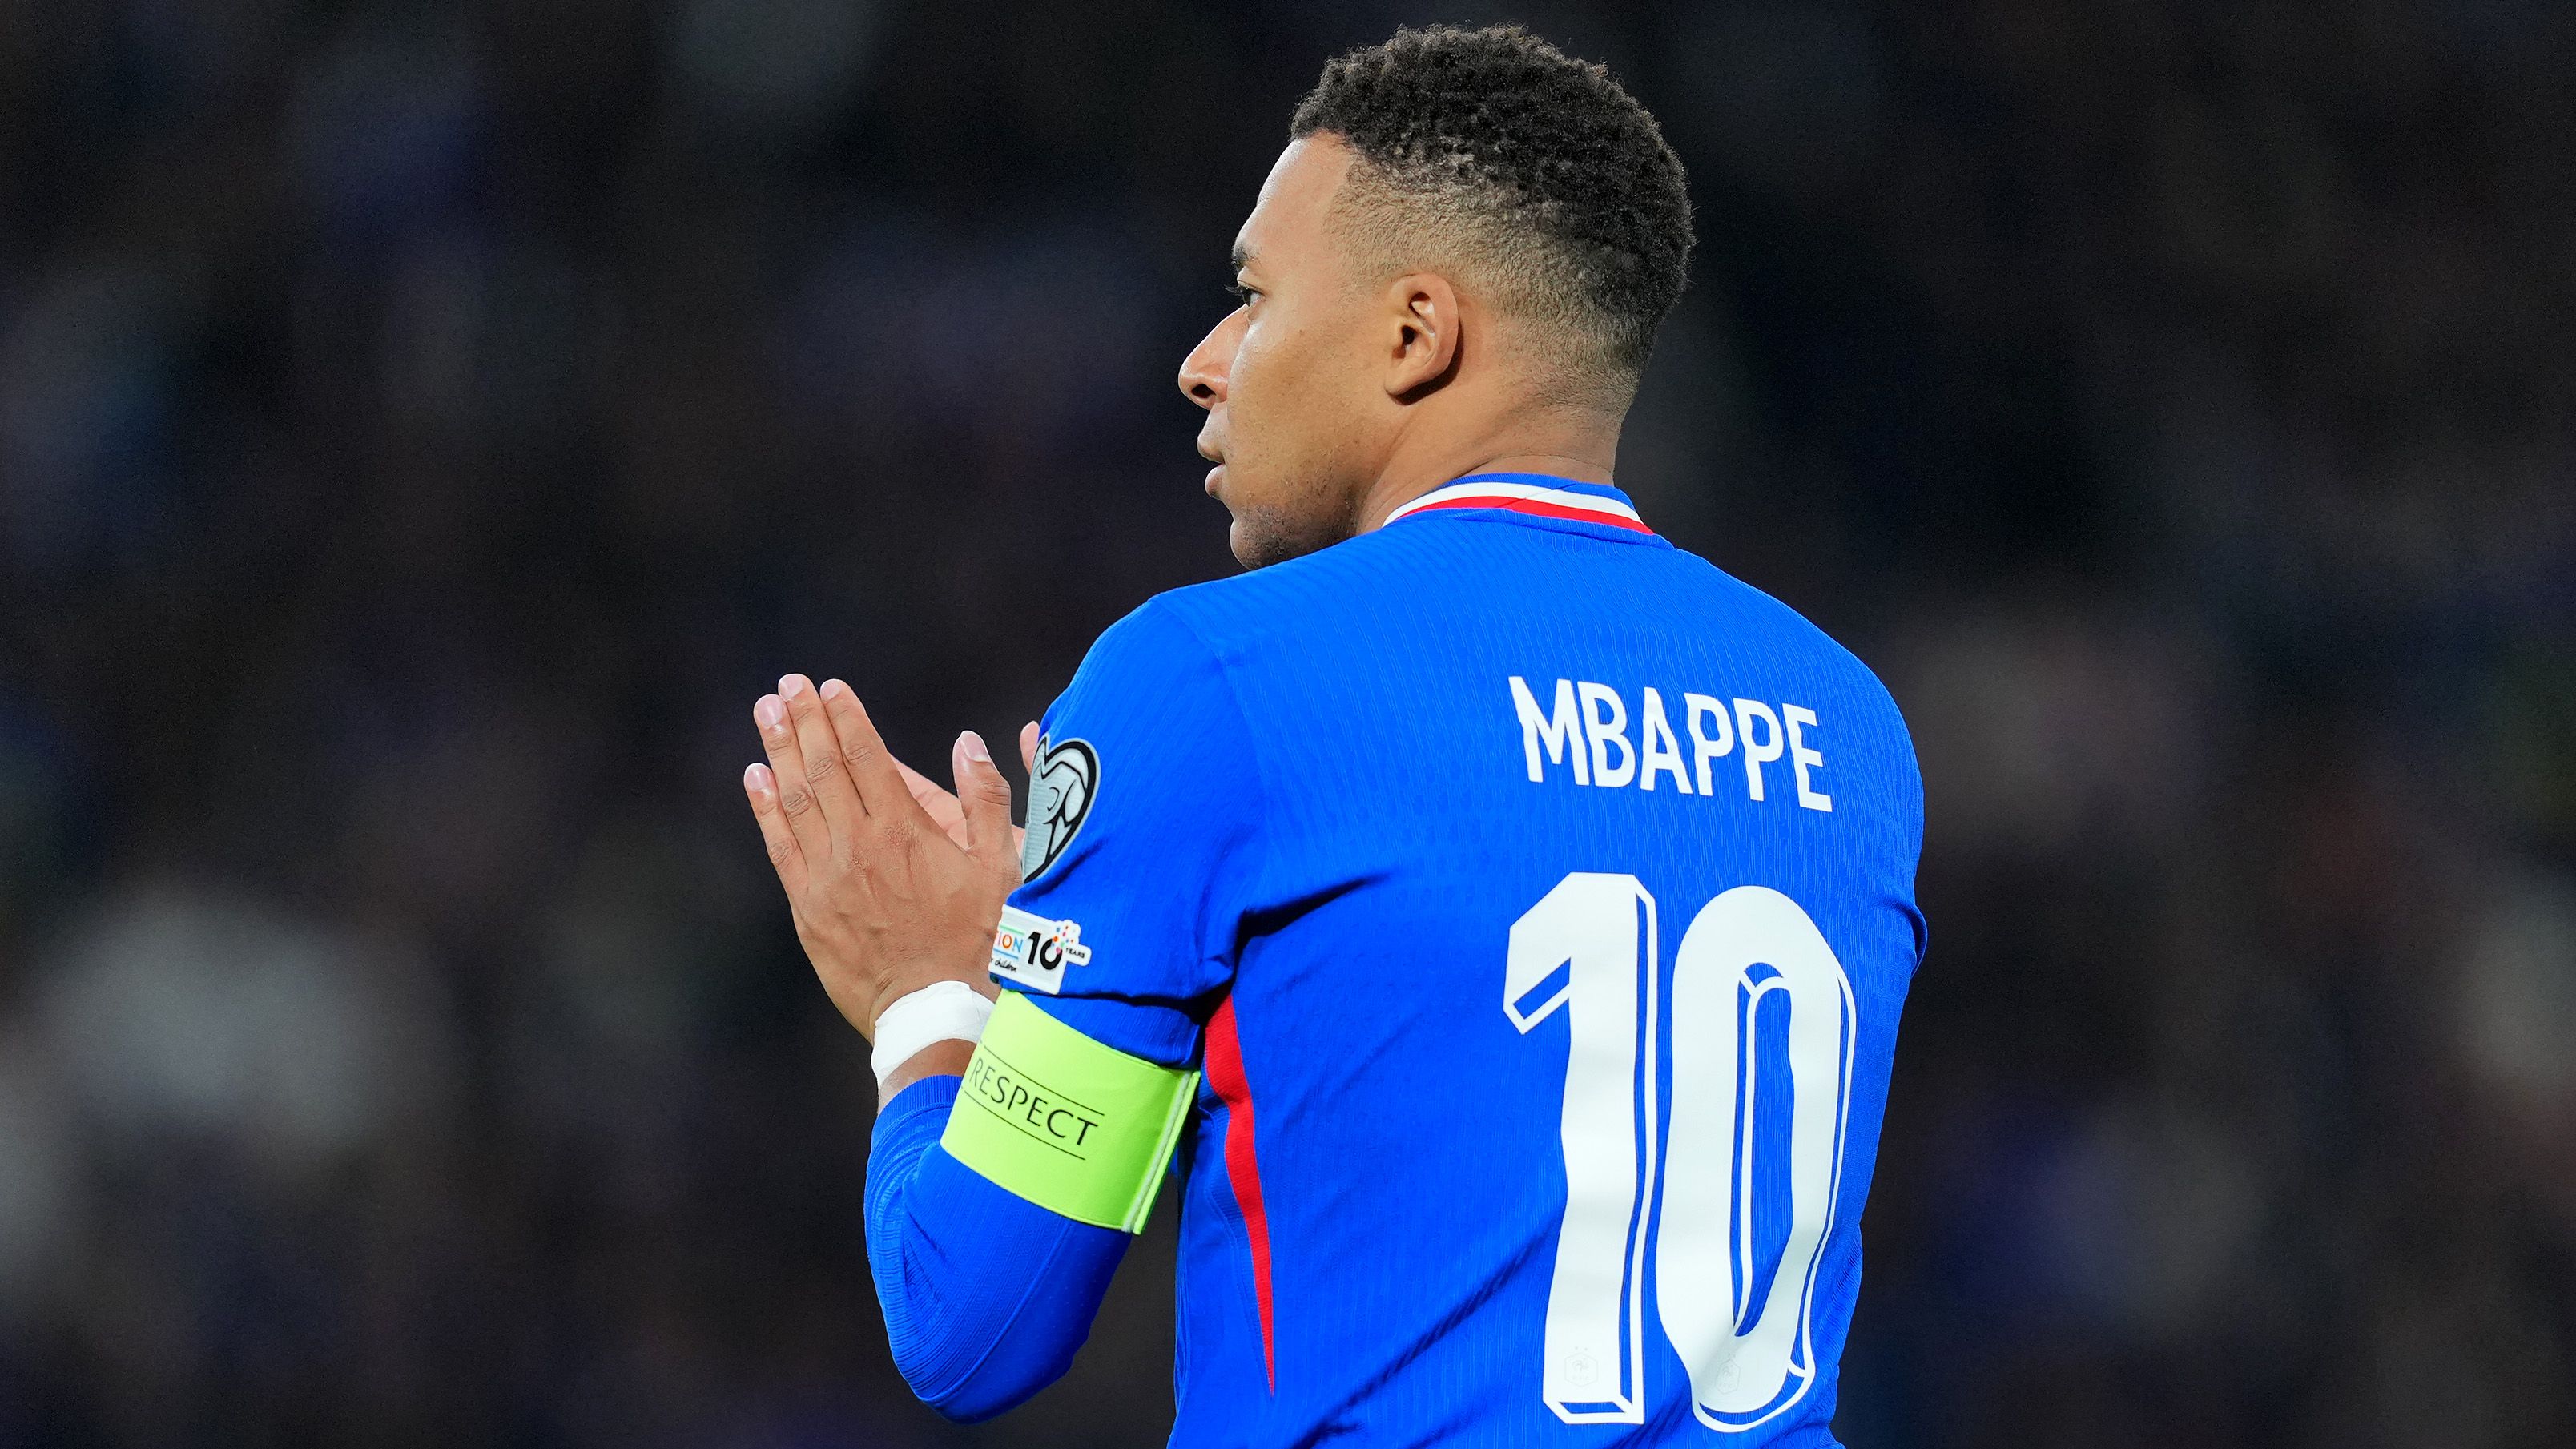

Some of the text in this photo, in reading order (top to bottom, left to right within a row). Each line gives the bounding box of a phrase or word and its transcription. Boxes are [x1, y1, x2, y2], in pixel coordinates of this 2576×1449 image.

[1508, 676, 1833, 812] MBAPPE
[1028, 931, 1085, 971] 10 YEARS
[968, 1057, 1099, 1146] RESPECT
[1503, 871, 1856, 1432] 10
